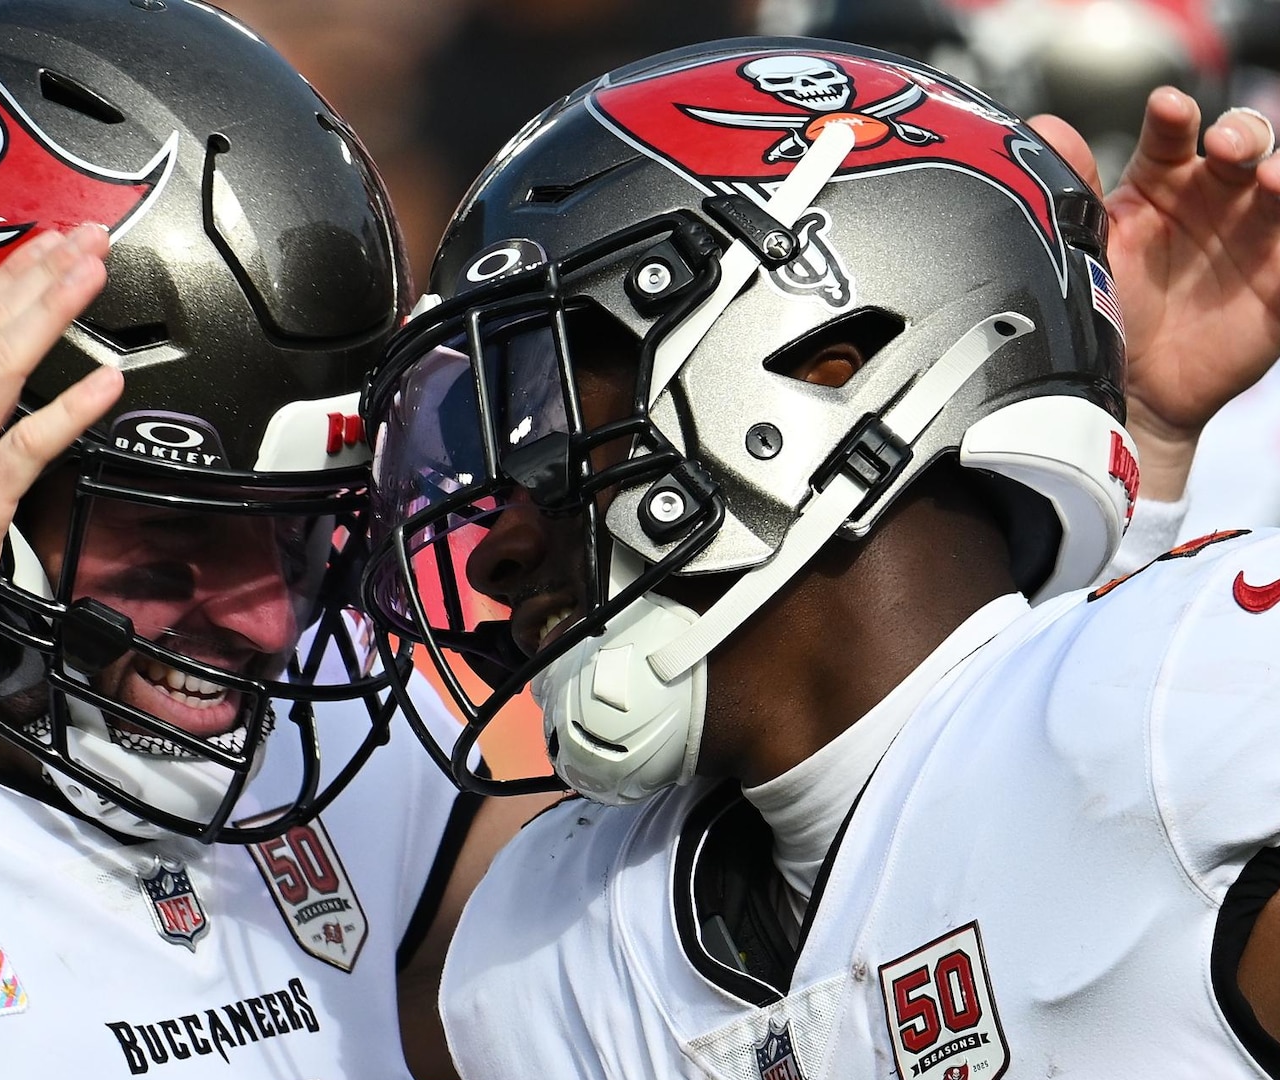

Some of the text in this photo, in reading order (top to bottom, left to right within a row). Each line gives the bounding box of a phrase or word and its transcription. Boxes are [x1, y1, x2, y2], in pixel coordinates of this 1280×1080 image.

[115, 437, 216, 467] OAKLEY
[257, 825, 340, 906] 50
[156, 895, 203, 934] NFL
[892, 948, 983, 1055] 50
[104, 977, 321, 1075] BUCCANEERS
[923, 1036, 976, 1067] SEASONS
[972, 1060, 989, 1073] 2025
